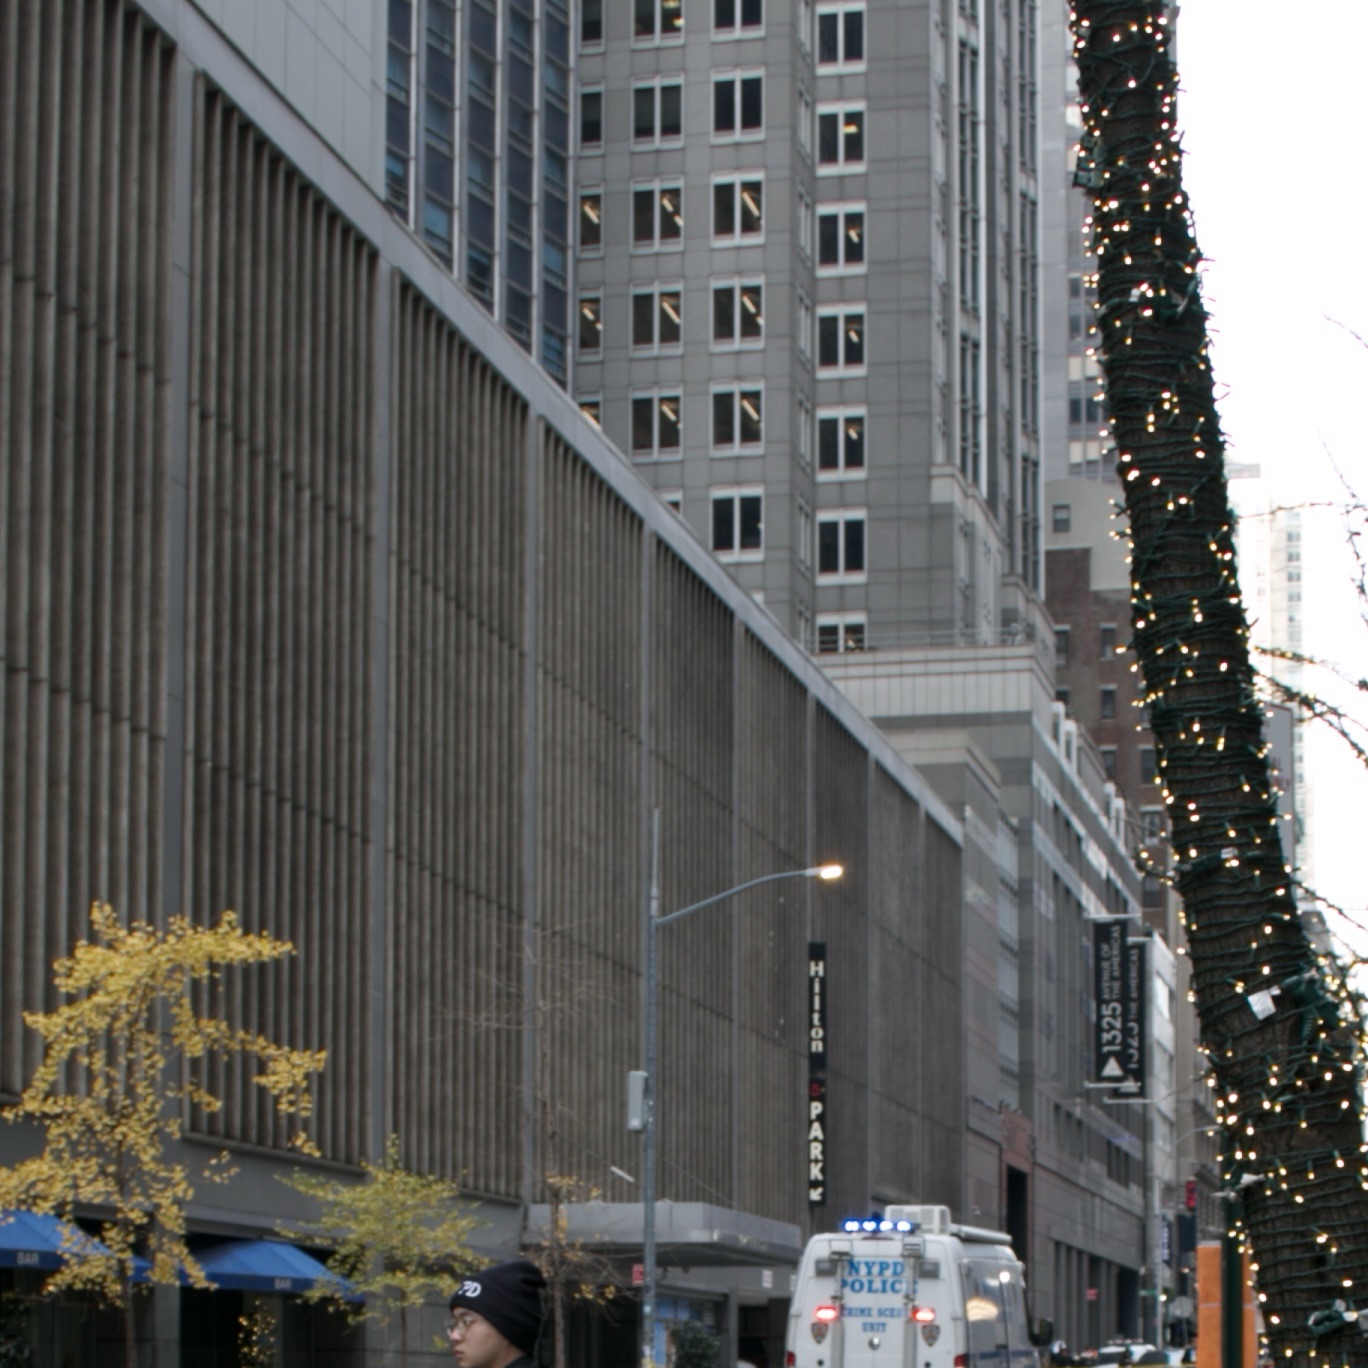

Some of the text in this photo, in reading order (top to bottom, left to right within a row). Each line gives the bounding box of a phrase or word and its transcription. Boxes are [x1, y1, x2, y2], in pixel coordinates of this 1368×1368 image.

[1101, 960, 1111, 1000] AVENUE
[1111, 924, 1121, 999] THE AMERICAS
[809, 961, 824, 1052] Hilton
[1101, 1002, 1122, 1053] 1325
[809, 1101, 824, 1180] PARK
[17, 1251, 39, 1265] BAR
[846, 1259, 904, 1276] NYPD
[862, 1322, 887, 1332] UNIT
